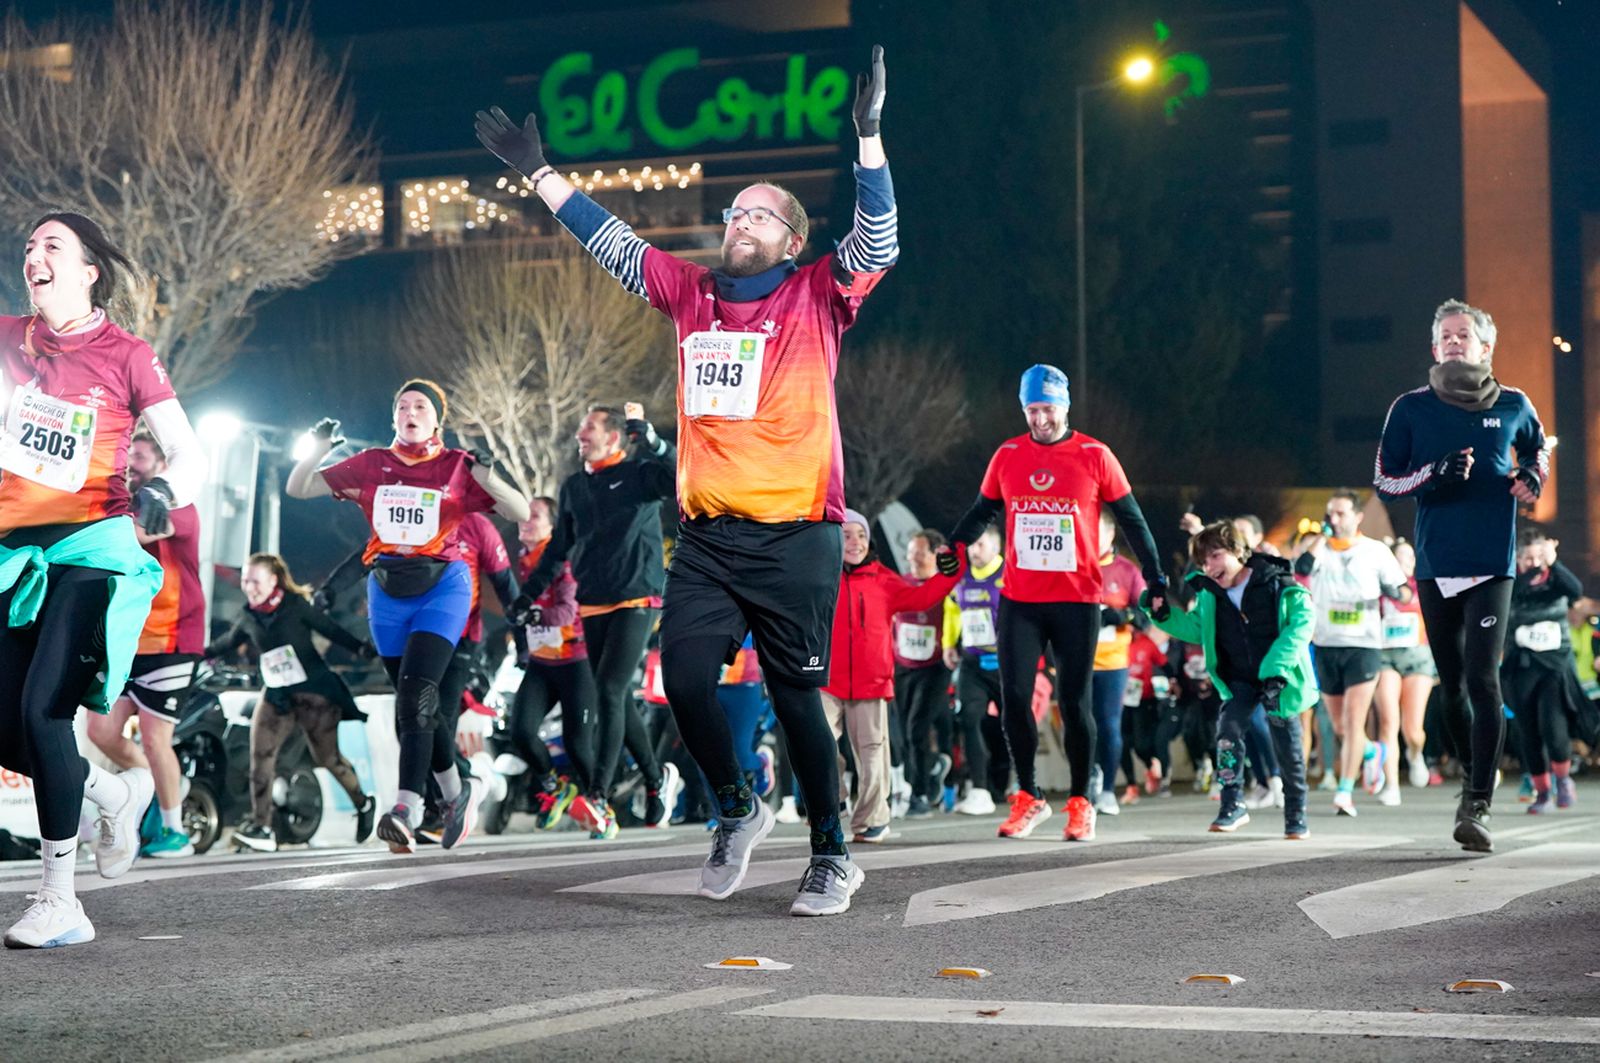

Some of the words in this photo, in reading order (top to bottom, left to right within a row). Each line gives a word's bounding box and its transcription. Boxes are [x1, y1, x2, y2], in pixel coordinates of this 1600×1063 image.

[540, 52, 632, 156] El
[637, 47, 850, 148] Corte
[696, 362, 743, 387] 1943
[19, 409, 37, 422] SAN
[32, 402, 56, 416] NOCHE
[56, 410, 67, 419] DE
[1483, 418, 1501, 428] HH
[19, 422, 77, 460] 2503
[388, 506, 424, 525] 1916
[1010, 501, 1080, 515] JUANMA
[1028, 535, 1063, 551] 1738
